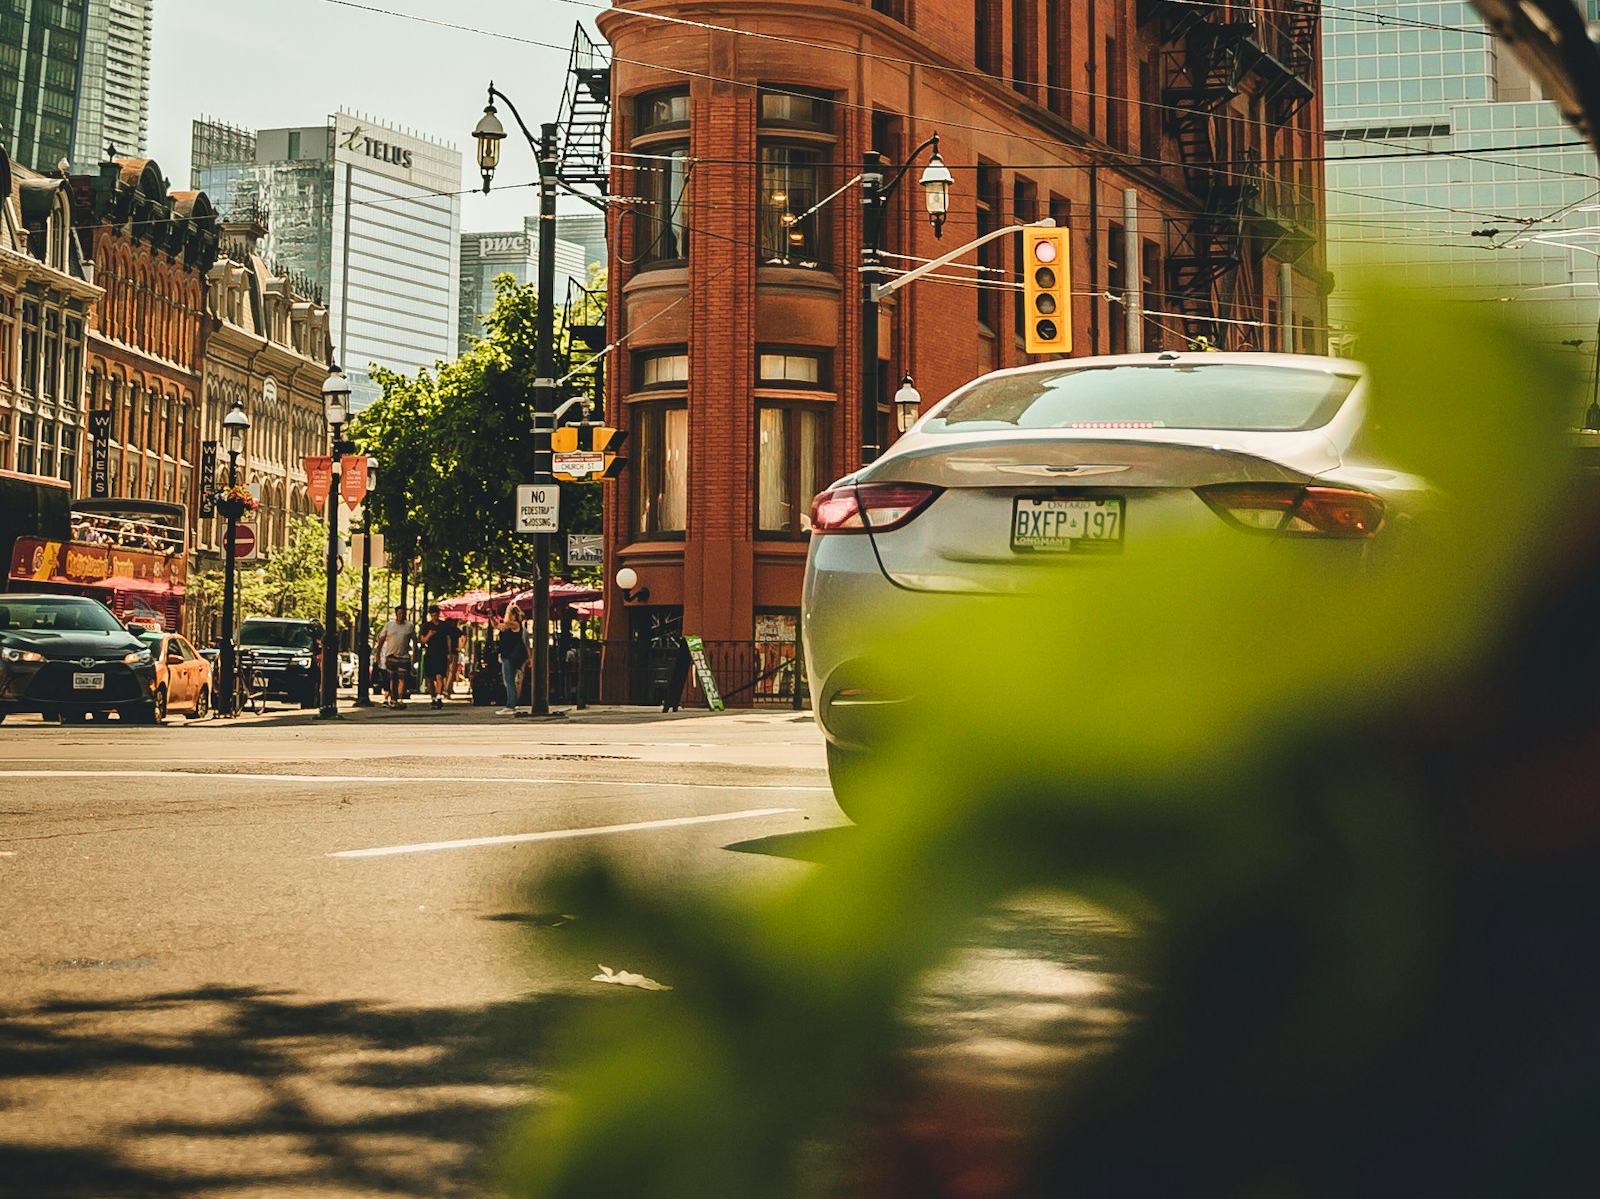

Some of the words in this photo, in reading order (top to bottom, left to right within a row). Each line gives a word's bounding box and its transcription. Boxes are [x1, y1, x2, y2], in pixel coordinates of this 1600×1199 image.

[364, 136, 412, 169] TELUS
[479, 236, 525, 258] pwc
[95, 417, 109, 493] WINNERS
[531, 490, 545, 503] NO
[1047, 501, 1090, 509] ONTARIO
[1017, 510, 1067, 538] BXFP
[1081, 511, 1118, 539] 197
